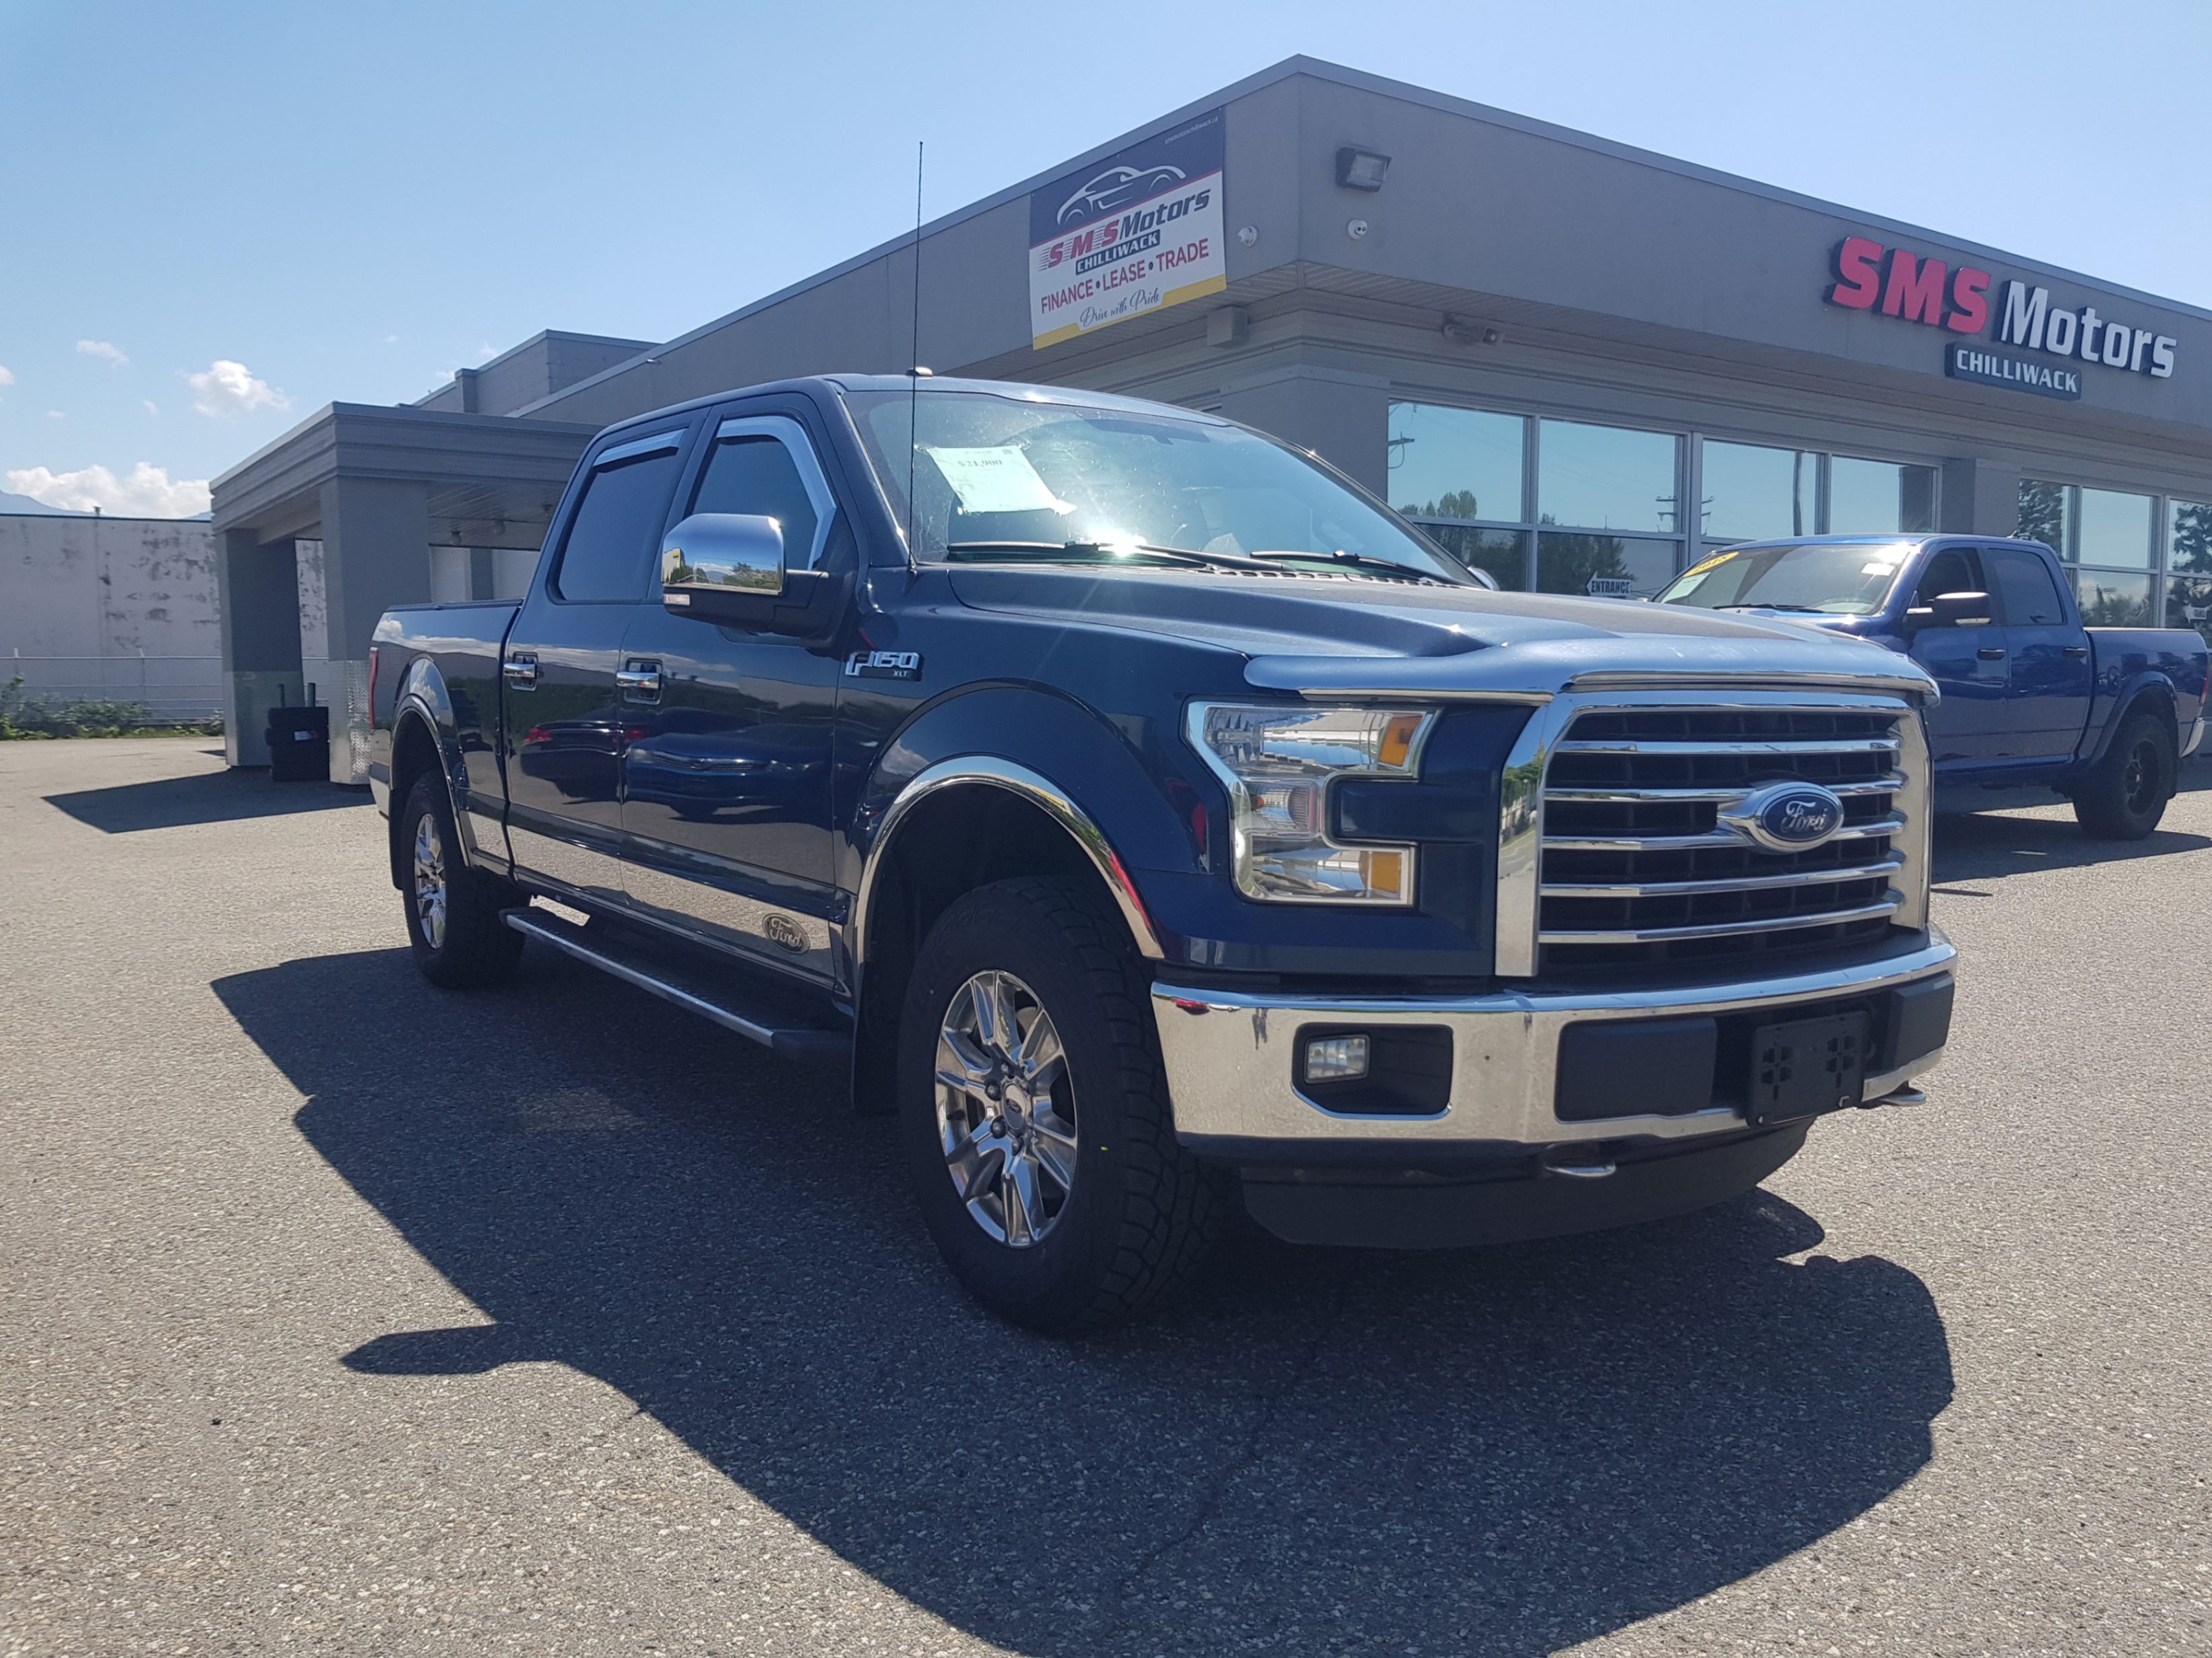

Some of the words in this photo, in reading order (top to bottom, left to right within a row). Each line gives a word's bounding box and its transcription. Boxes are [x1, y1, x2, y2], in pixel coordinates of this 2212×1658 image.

[1047, 219, 1120, 269] SMS
[1119, 189, 1211, 240] Motors
[1077, 232, 1159, 272] CHILLIWACK
[1041, 278, 1094, 314] FINANCE
[1102, 260, 1146, 291] LEASE
[1156, 238, 1209, 272] TRADE
[1080, 307, 1108, 327] Drive
[1110, 298, 1127, 317] with
[1129, 288, 1160, 310] Pride
[1830, 236, 1991, 333] SMS
[2000, 280, 2178, 379] Motors
[1956, 348, 2078, 393] CHILLIWACK
[1591, 581, 1631, 594] ENTRANCE
[1780, 800, 1829, 833] Ford
[770, 918, 802, 947] Ford
